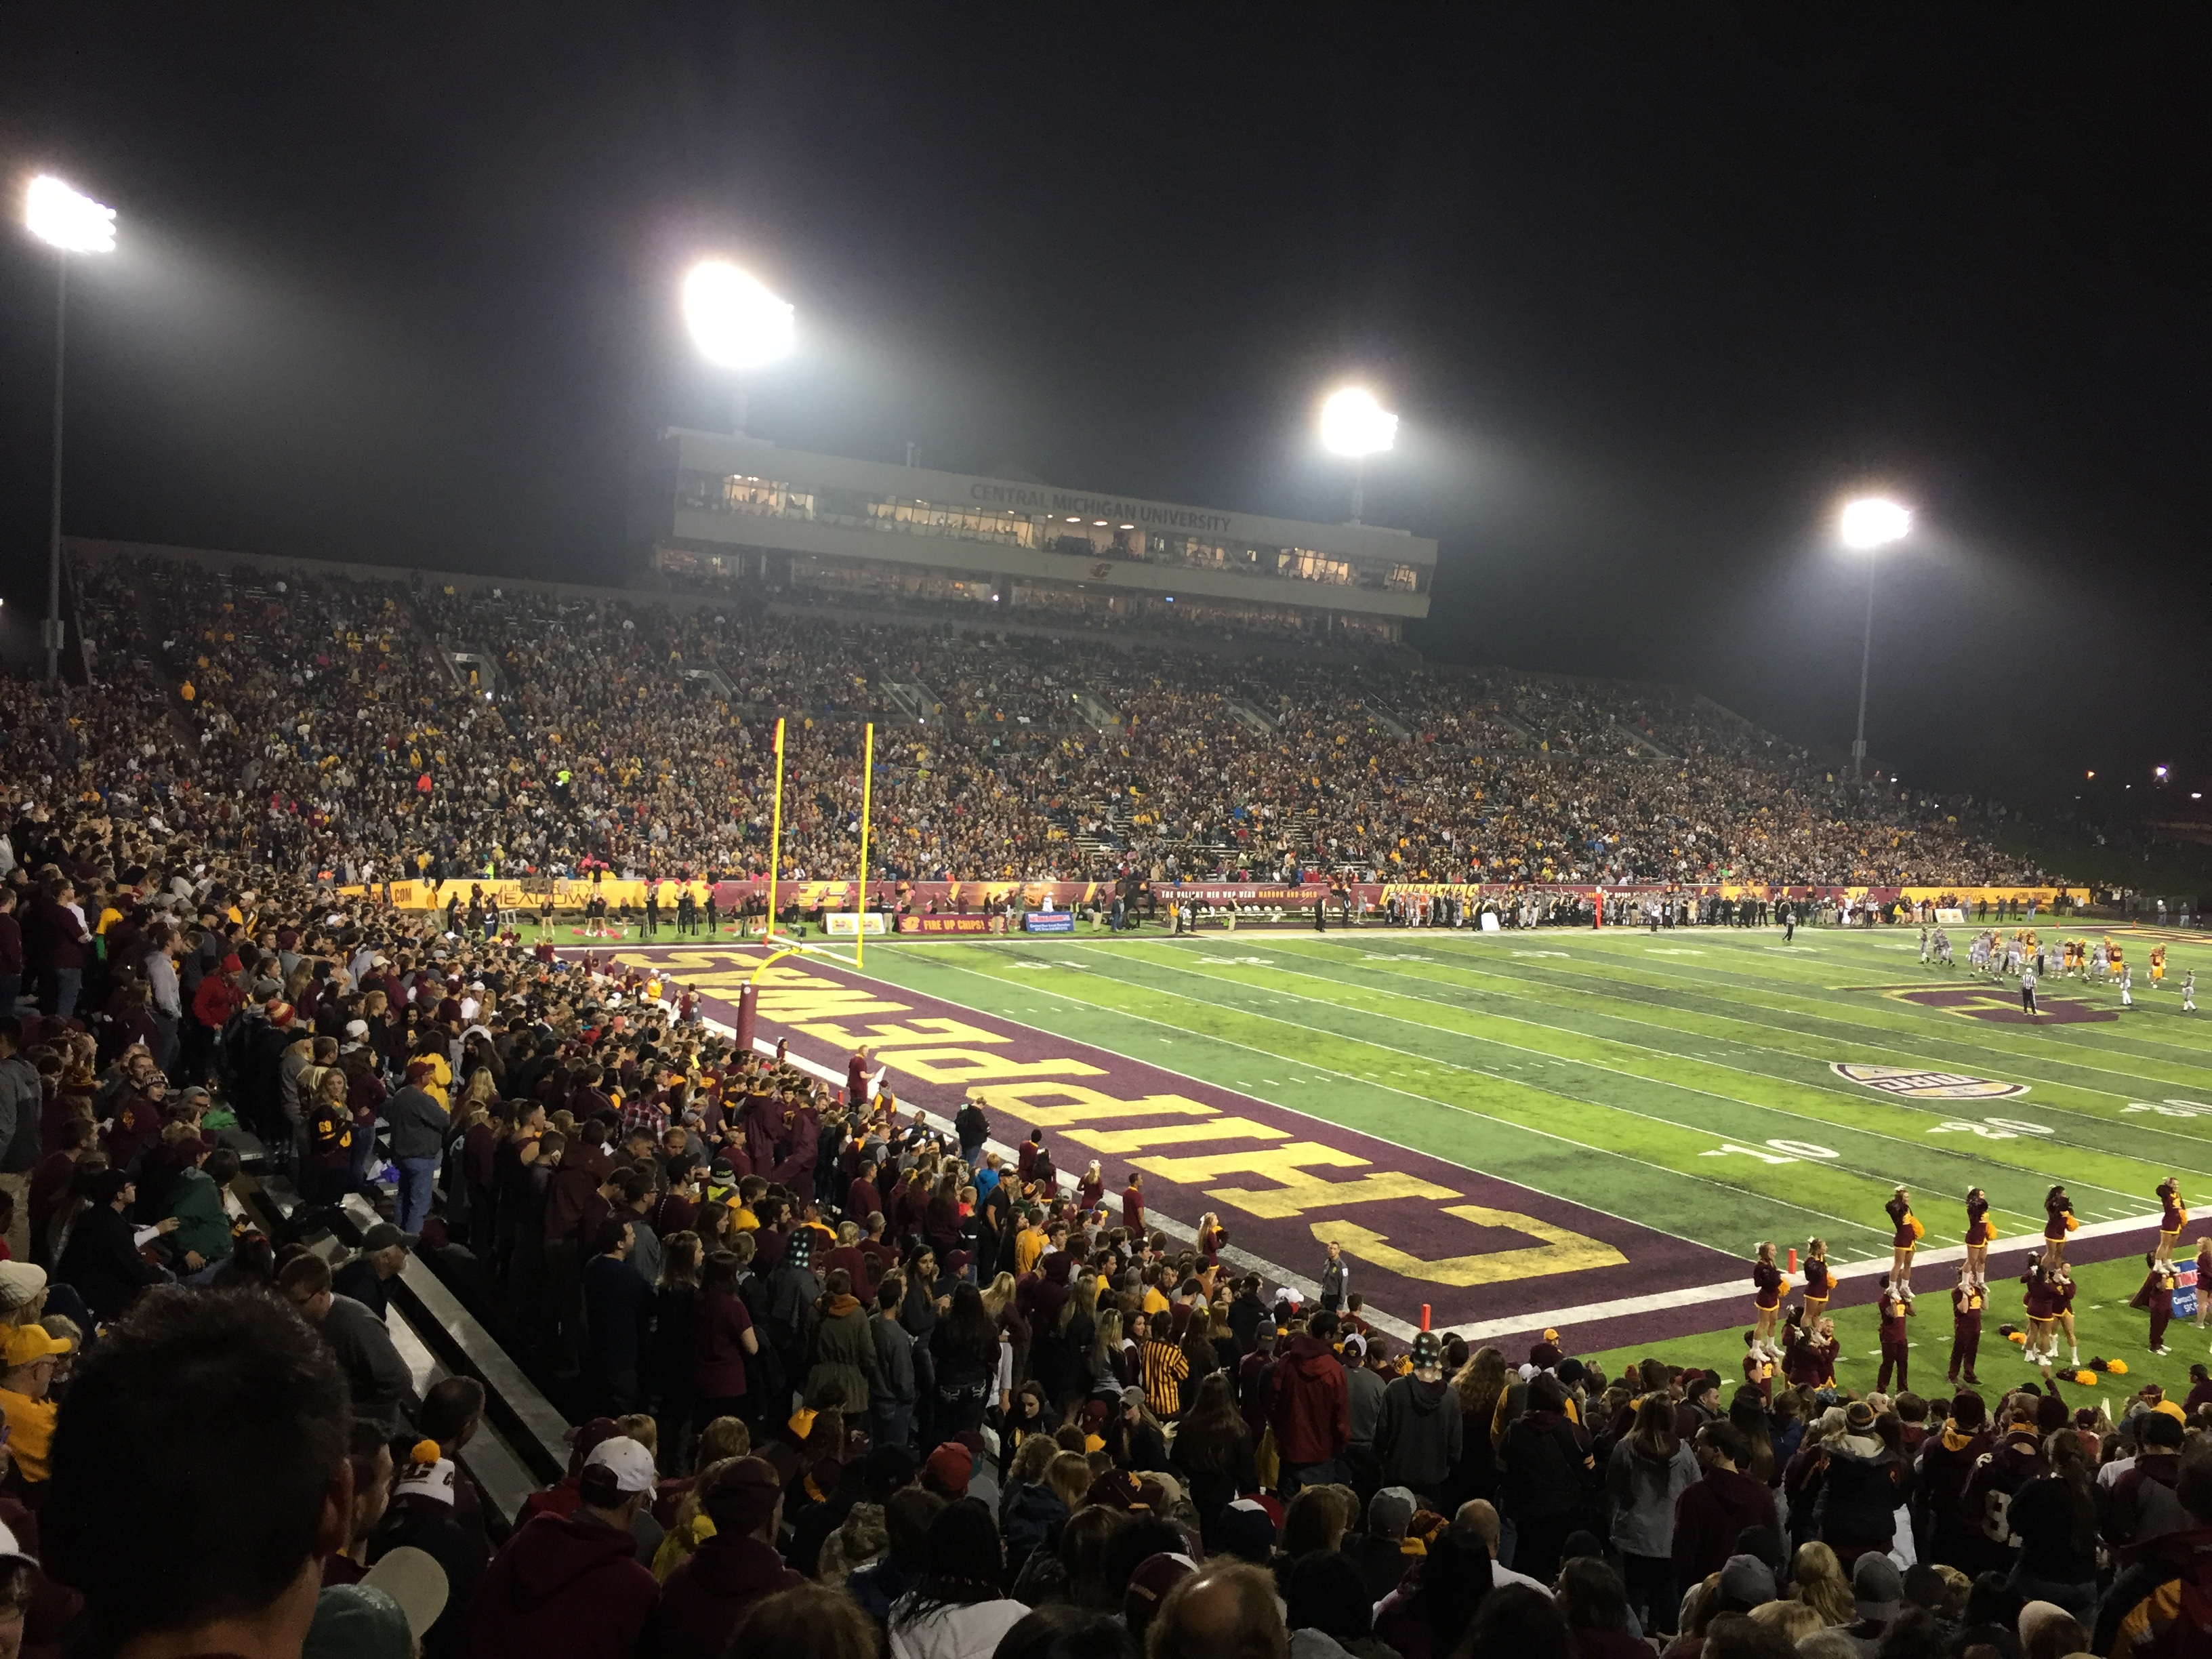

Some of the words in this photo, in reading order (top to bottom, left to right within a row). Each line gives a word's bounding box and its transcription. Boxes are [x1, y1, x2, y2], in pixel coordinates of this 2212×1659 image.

[970, 484, 1048, 508] CENTRAL
[1052, 494, 1136, 520] MICHIGAN
[1141, 506, 1231, 532] UNIVERSITY
[924, 920, 942, 930] FIRE
[943, 920, 955, 930] UP
[958, 920, 985, 930] CHIPS!
[319, 1120, 332, 1133] 69
[613, 951, 1630, 1285] CHIPPEWAS
[1940, 1117, 2055, 1139] 20
[1719, 1139, 1841, 1164] 10
